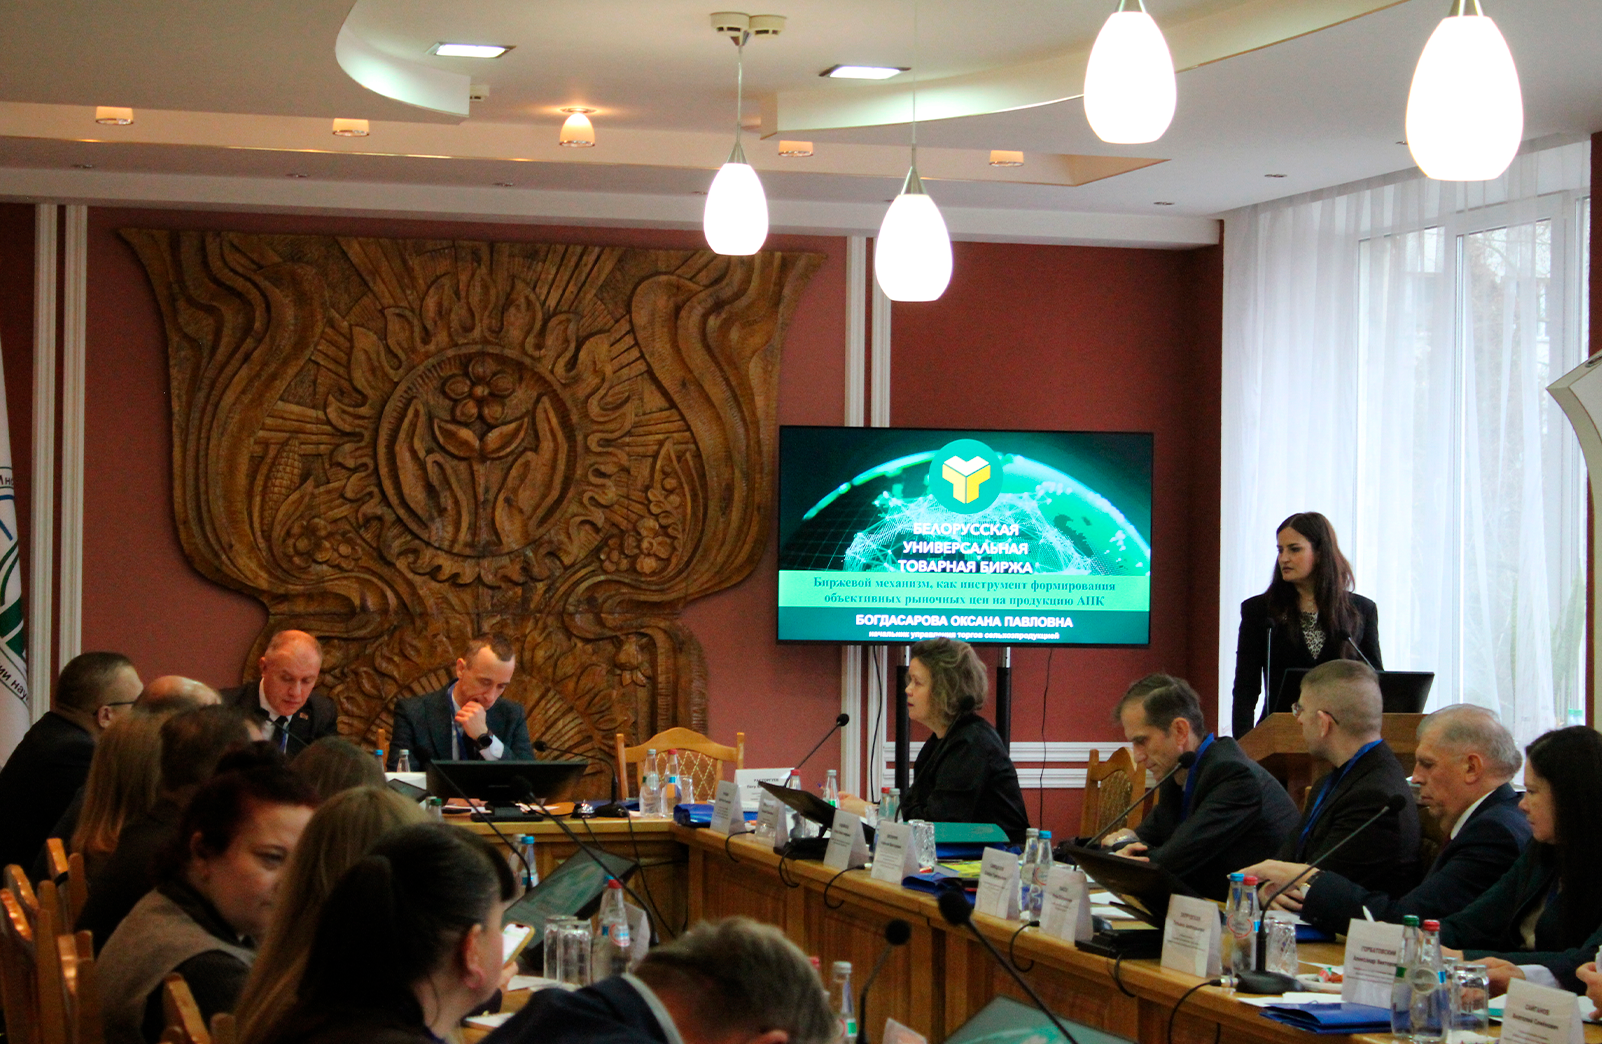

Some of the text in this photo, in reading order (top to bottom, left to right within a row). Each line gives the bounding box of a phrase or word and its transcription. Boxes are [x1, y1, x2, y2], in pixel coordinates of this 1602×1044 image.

[912, 522, 1020, 537] БЕЛОРУССКАЯ
[902, 541, 1029, 556] УНИВЕРСАЛЬНАЯ
[897, 559, 1033, 575] ТОВАРНАЯ БИРЖА
[813, 576, 1116, 593] Биржевой механизм, как инструмент формирования
[824, 592, 1105, 608] объективных рыночных цен на продукцию АПК
[855, 614, 1074, 628] БОГДАСАРОВА ОКСАНА ПАВЛОВНА
[957, 632, 983, 640] торгов
[11, 679, 29, 701] нау
